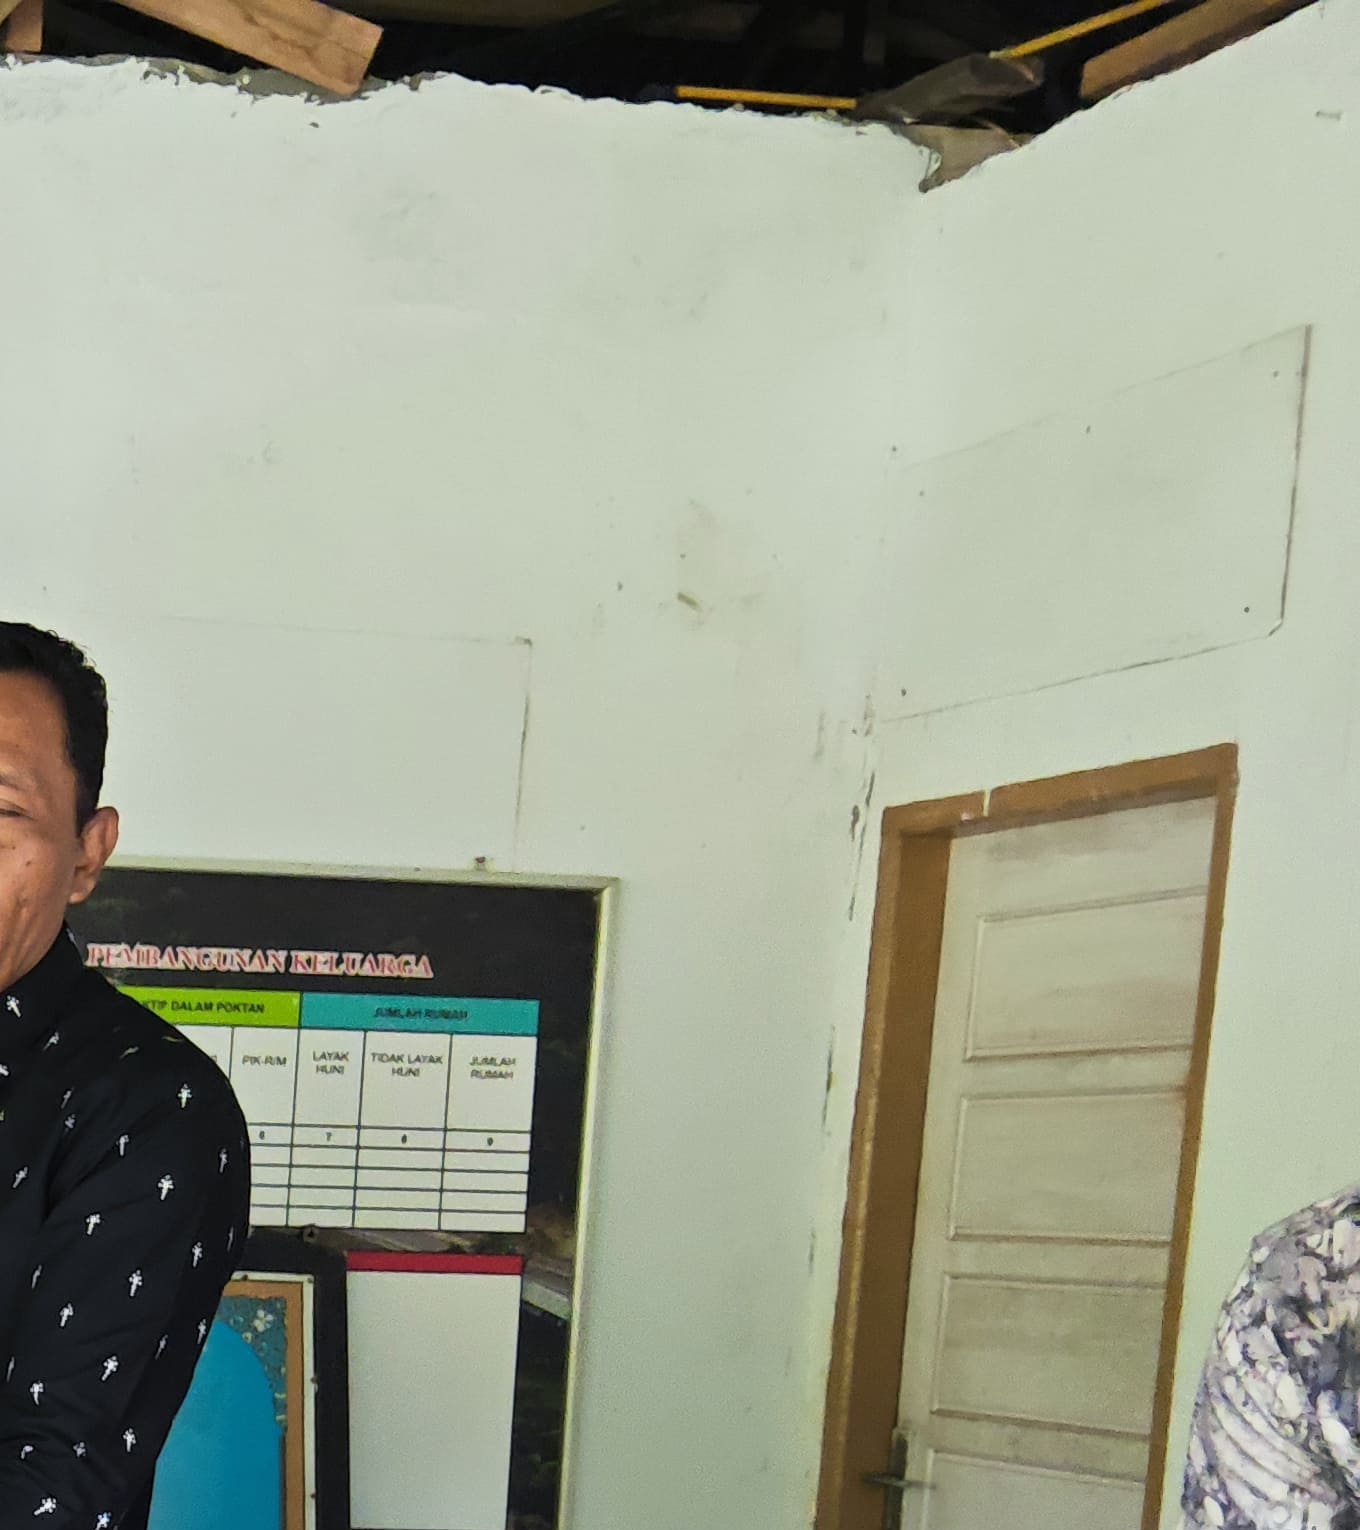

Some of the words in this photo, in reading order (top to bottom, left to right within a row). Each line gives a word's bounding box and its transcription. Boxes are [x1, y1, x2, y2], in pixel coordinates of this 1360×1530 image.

[84, 943, 287, 973] PEMBANGUNAN
[289, 950, 434, 979] KELUARGA
[170, 1001, 214, 1014] DALAM
[313, 1052, 349, 1063] LAYAK
[371, 1053, 404, 1065] TIDAK
[408, 1055, 443, 1066] LAYAK
